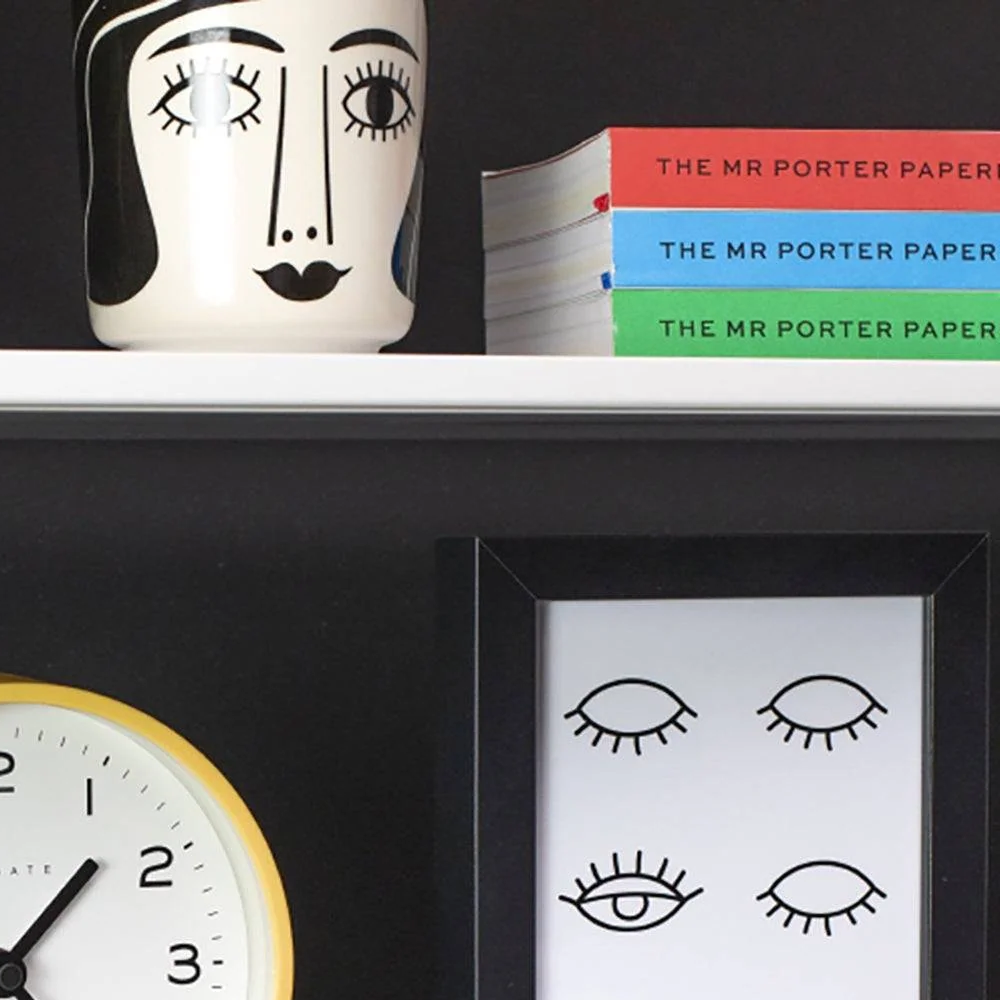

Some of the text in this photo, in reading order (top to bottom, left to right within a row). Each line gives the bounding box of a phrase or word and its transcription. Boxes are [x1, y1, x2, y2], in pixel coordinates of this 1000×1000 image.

[656, 158, 1000, 180] THE MR PORTER PAPER
[659, 241, 996, 262] THE MR PORTER PAPER
[658, 319, 996, 340] THE MR PORTER PAPER
[86, 777, 93, 816] 1
[139, 845, 174, 888] 2
[167, 943, 201, 985] 3
